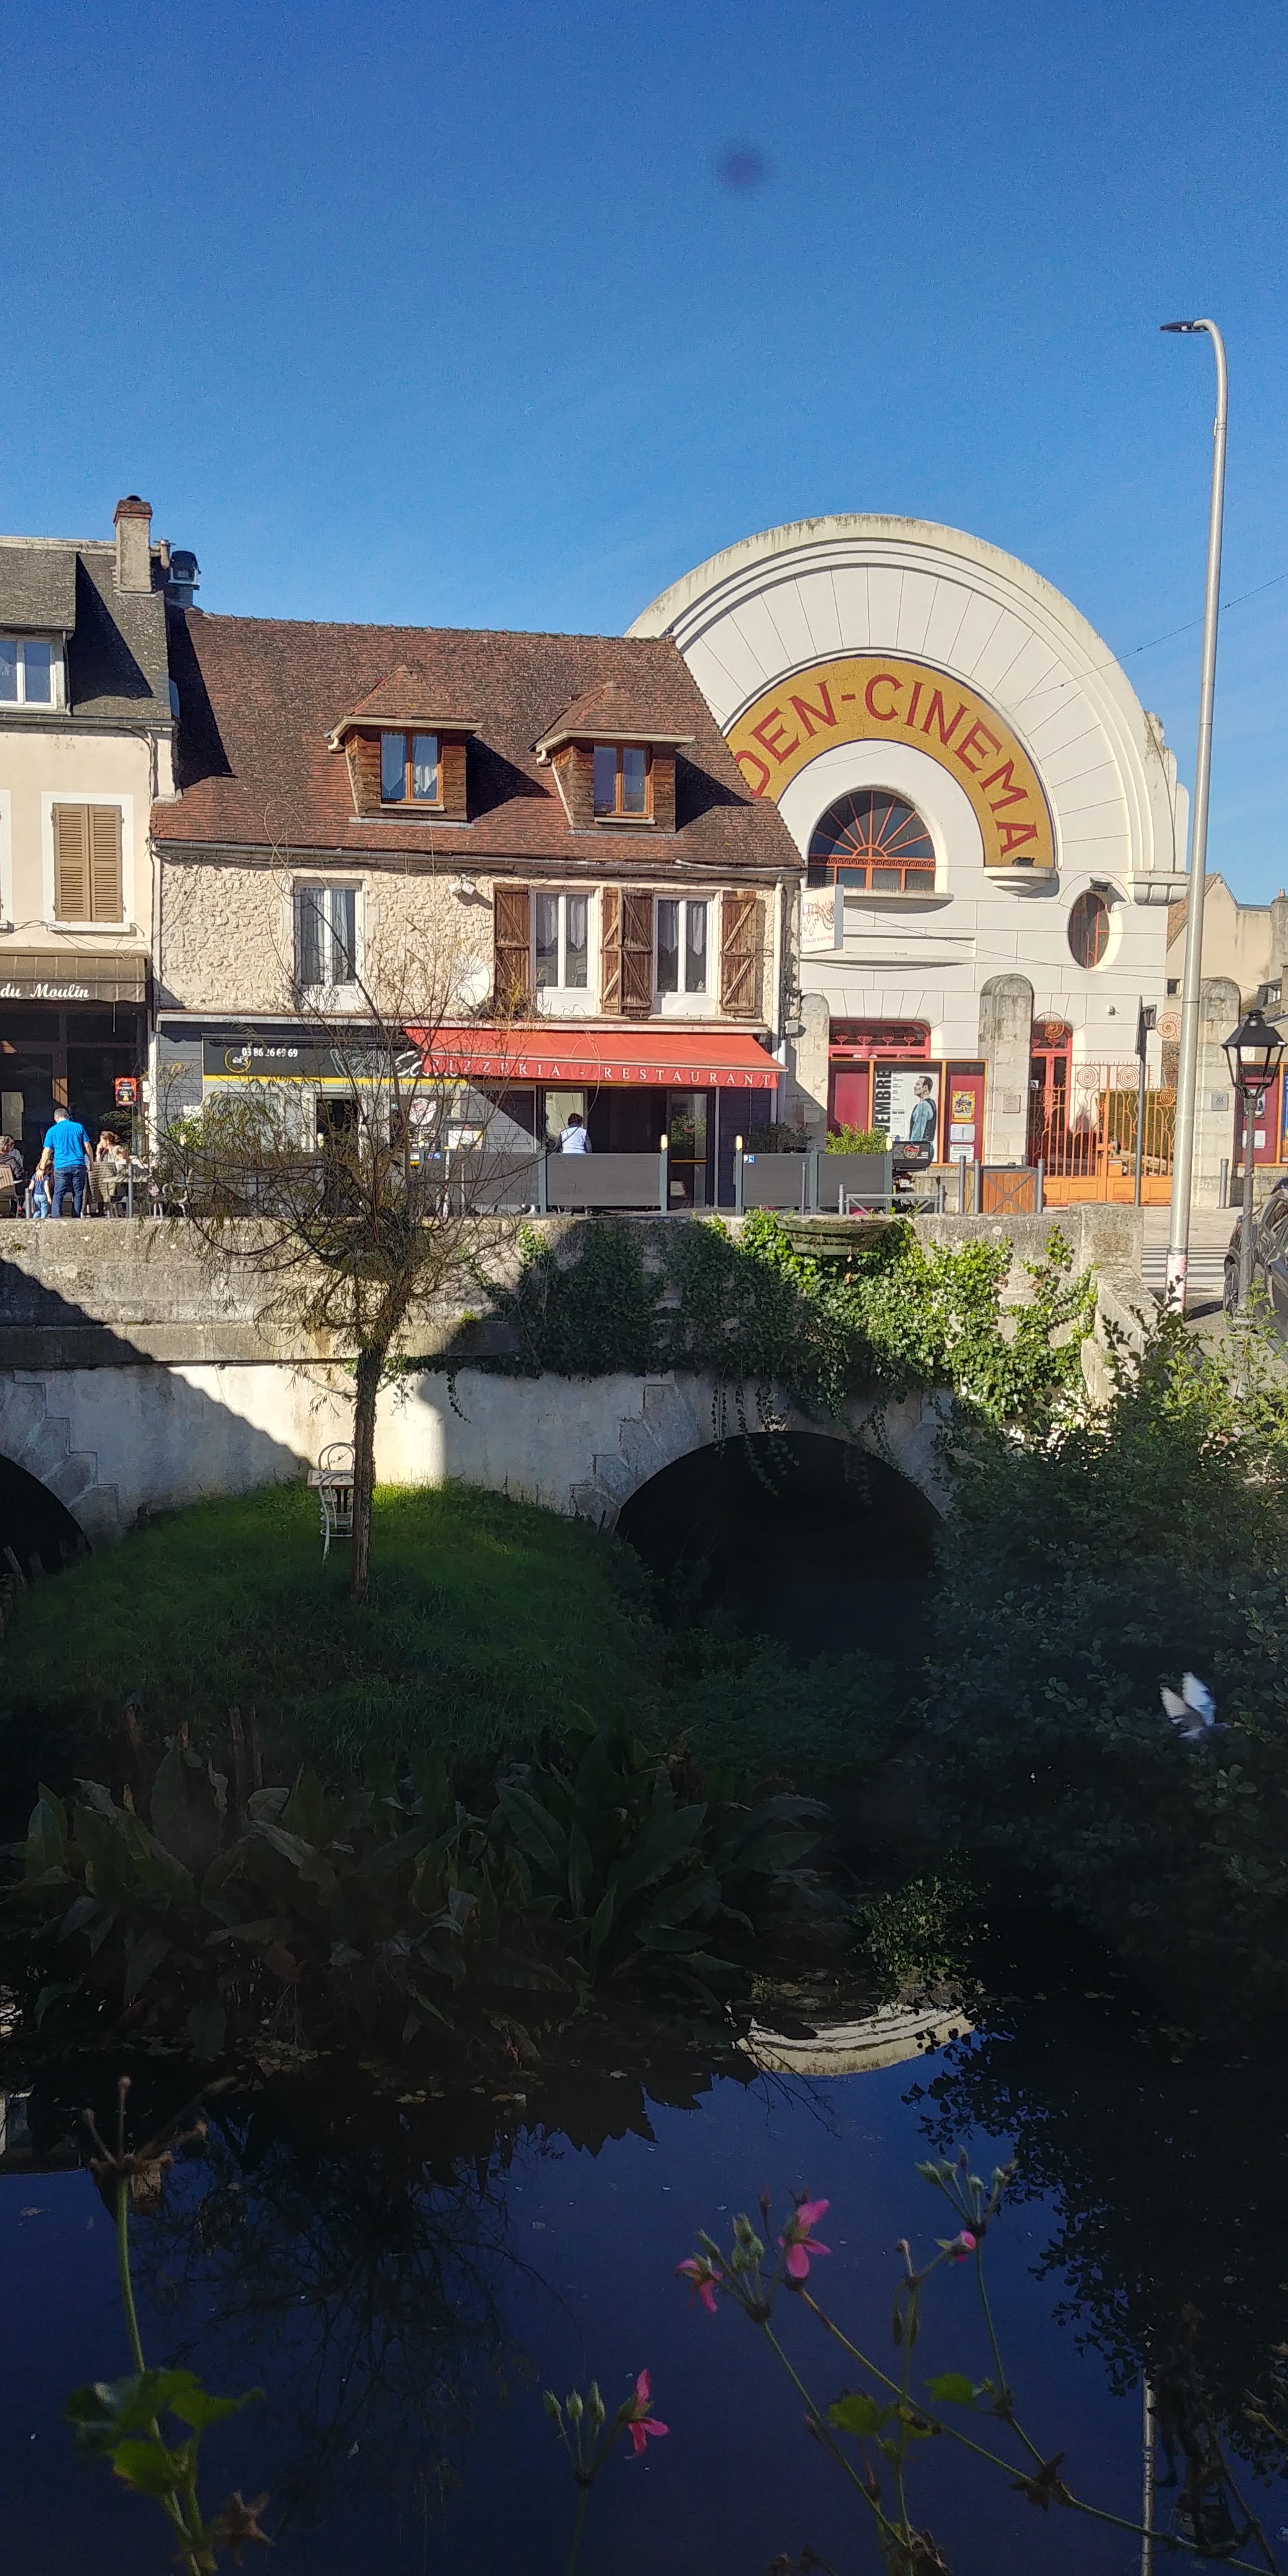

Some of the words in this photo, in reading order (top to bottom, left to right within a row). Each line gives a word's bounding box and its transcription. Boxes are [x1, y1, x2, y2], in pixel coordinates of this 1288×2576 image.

[0, 983, 22, 997] du
[30, 983, 90, 998] Moulin
[242, 1047, 251, 1056] 03
[253, 1048, 263, 1056] 86
[288, 1048, 298, 1057] 69
[432, 1059, 561, 1076] PIZZERIA
[604, 1066, 770, 1086] RESTAURANT
